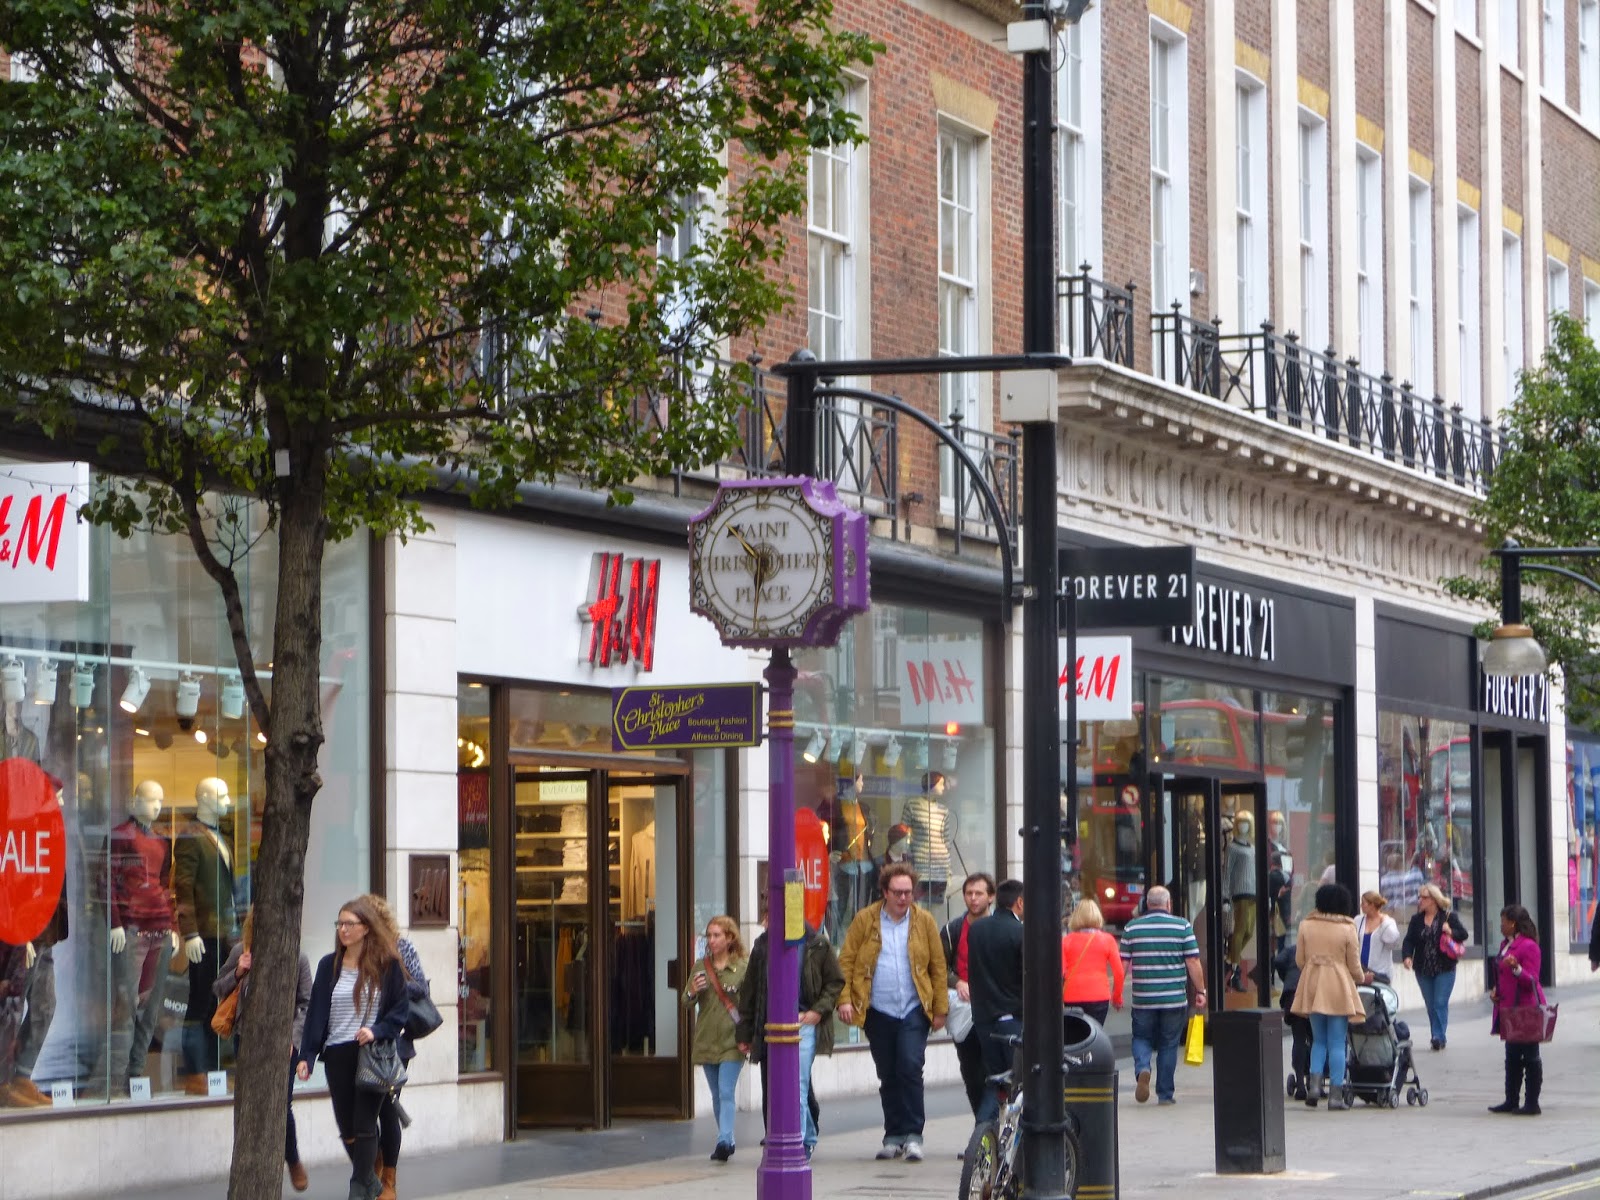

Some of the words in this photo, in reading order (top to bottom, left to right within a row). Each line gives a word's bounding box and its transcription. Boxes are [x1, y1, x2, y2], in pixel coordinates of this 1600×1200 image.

[735, 585, 791, 603] PLACE
[1061, 574, 1157, 600] FOREVER
[1168, 573, 1187, 599] 21
[588, 551, 661, 673] H&M
[1260, 599, 1275, 662] 21
[621, 693, 705, 733] Christopher's
[1539, 671, 1549, 724] 21
[648, 718, 681, 743] Place
[688, 717, 719, 727] Boutique
[721, 715, 748, 726] Fashion
[691, 732, 719, 742] Alfresco
[720, 731, 744, 742] Dining
[0, 829, 50, 873] ALE
[795, 858, 822, 889] ALE
